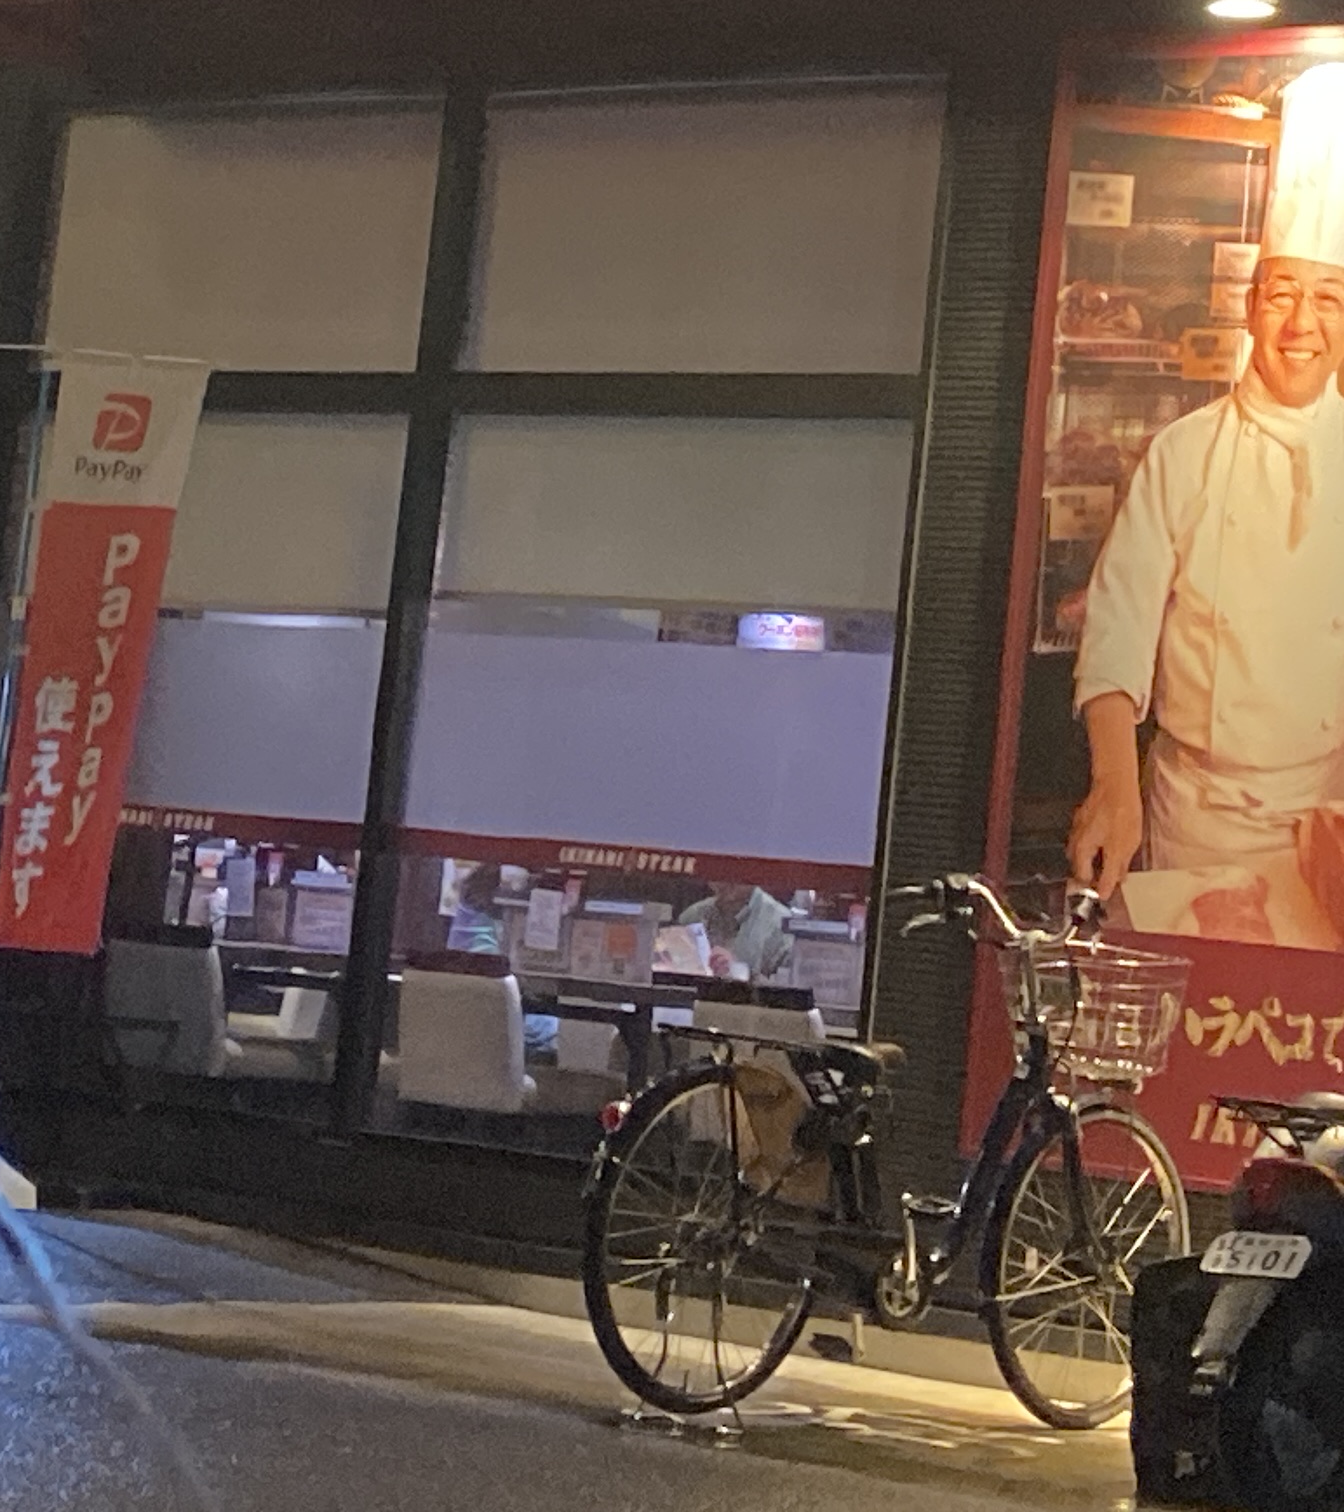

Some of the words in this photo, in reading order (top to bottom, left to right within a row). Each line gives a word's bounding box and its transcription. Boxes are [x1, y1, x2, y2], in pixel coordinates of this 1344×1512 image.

[74, 454, 144, 484] PayPay
[12, 675, 79, 919] 使えます
